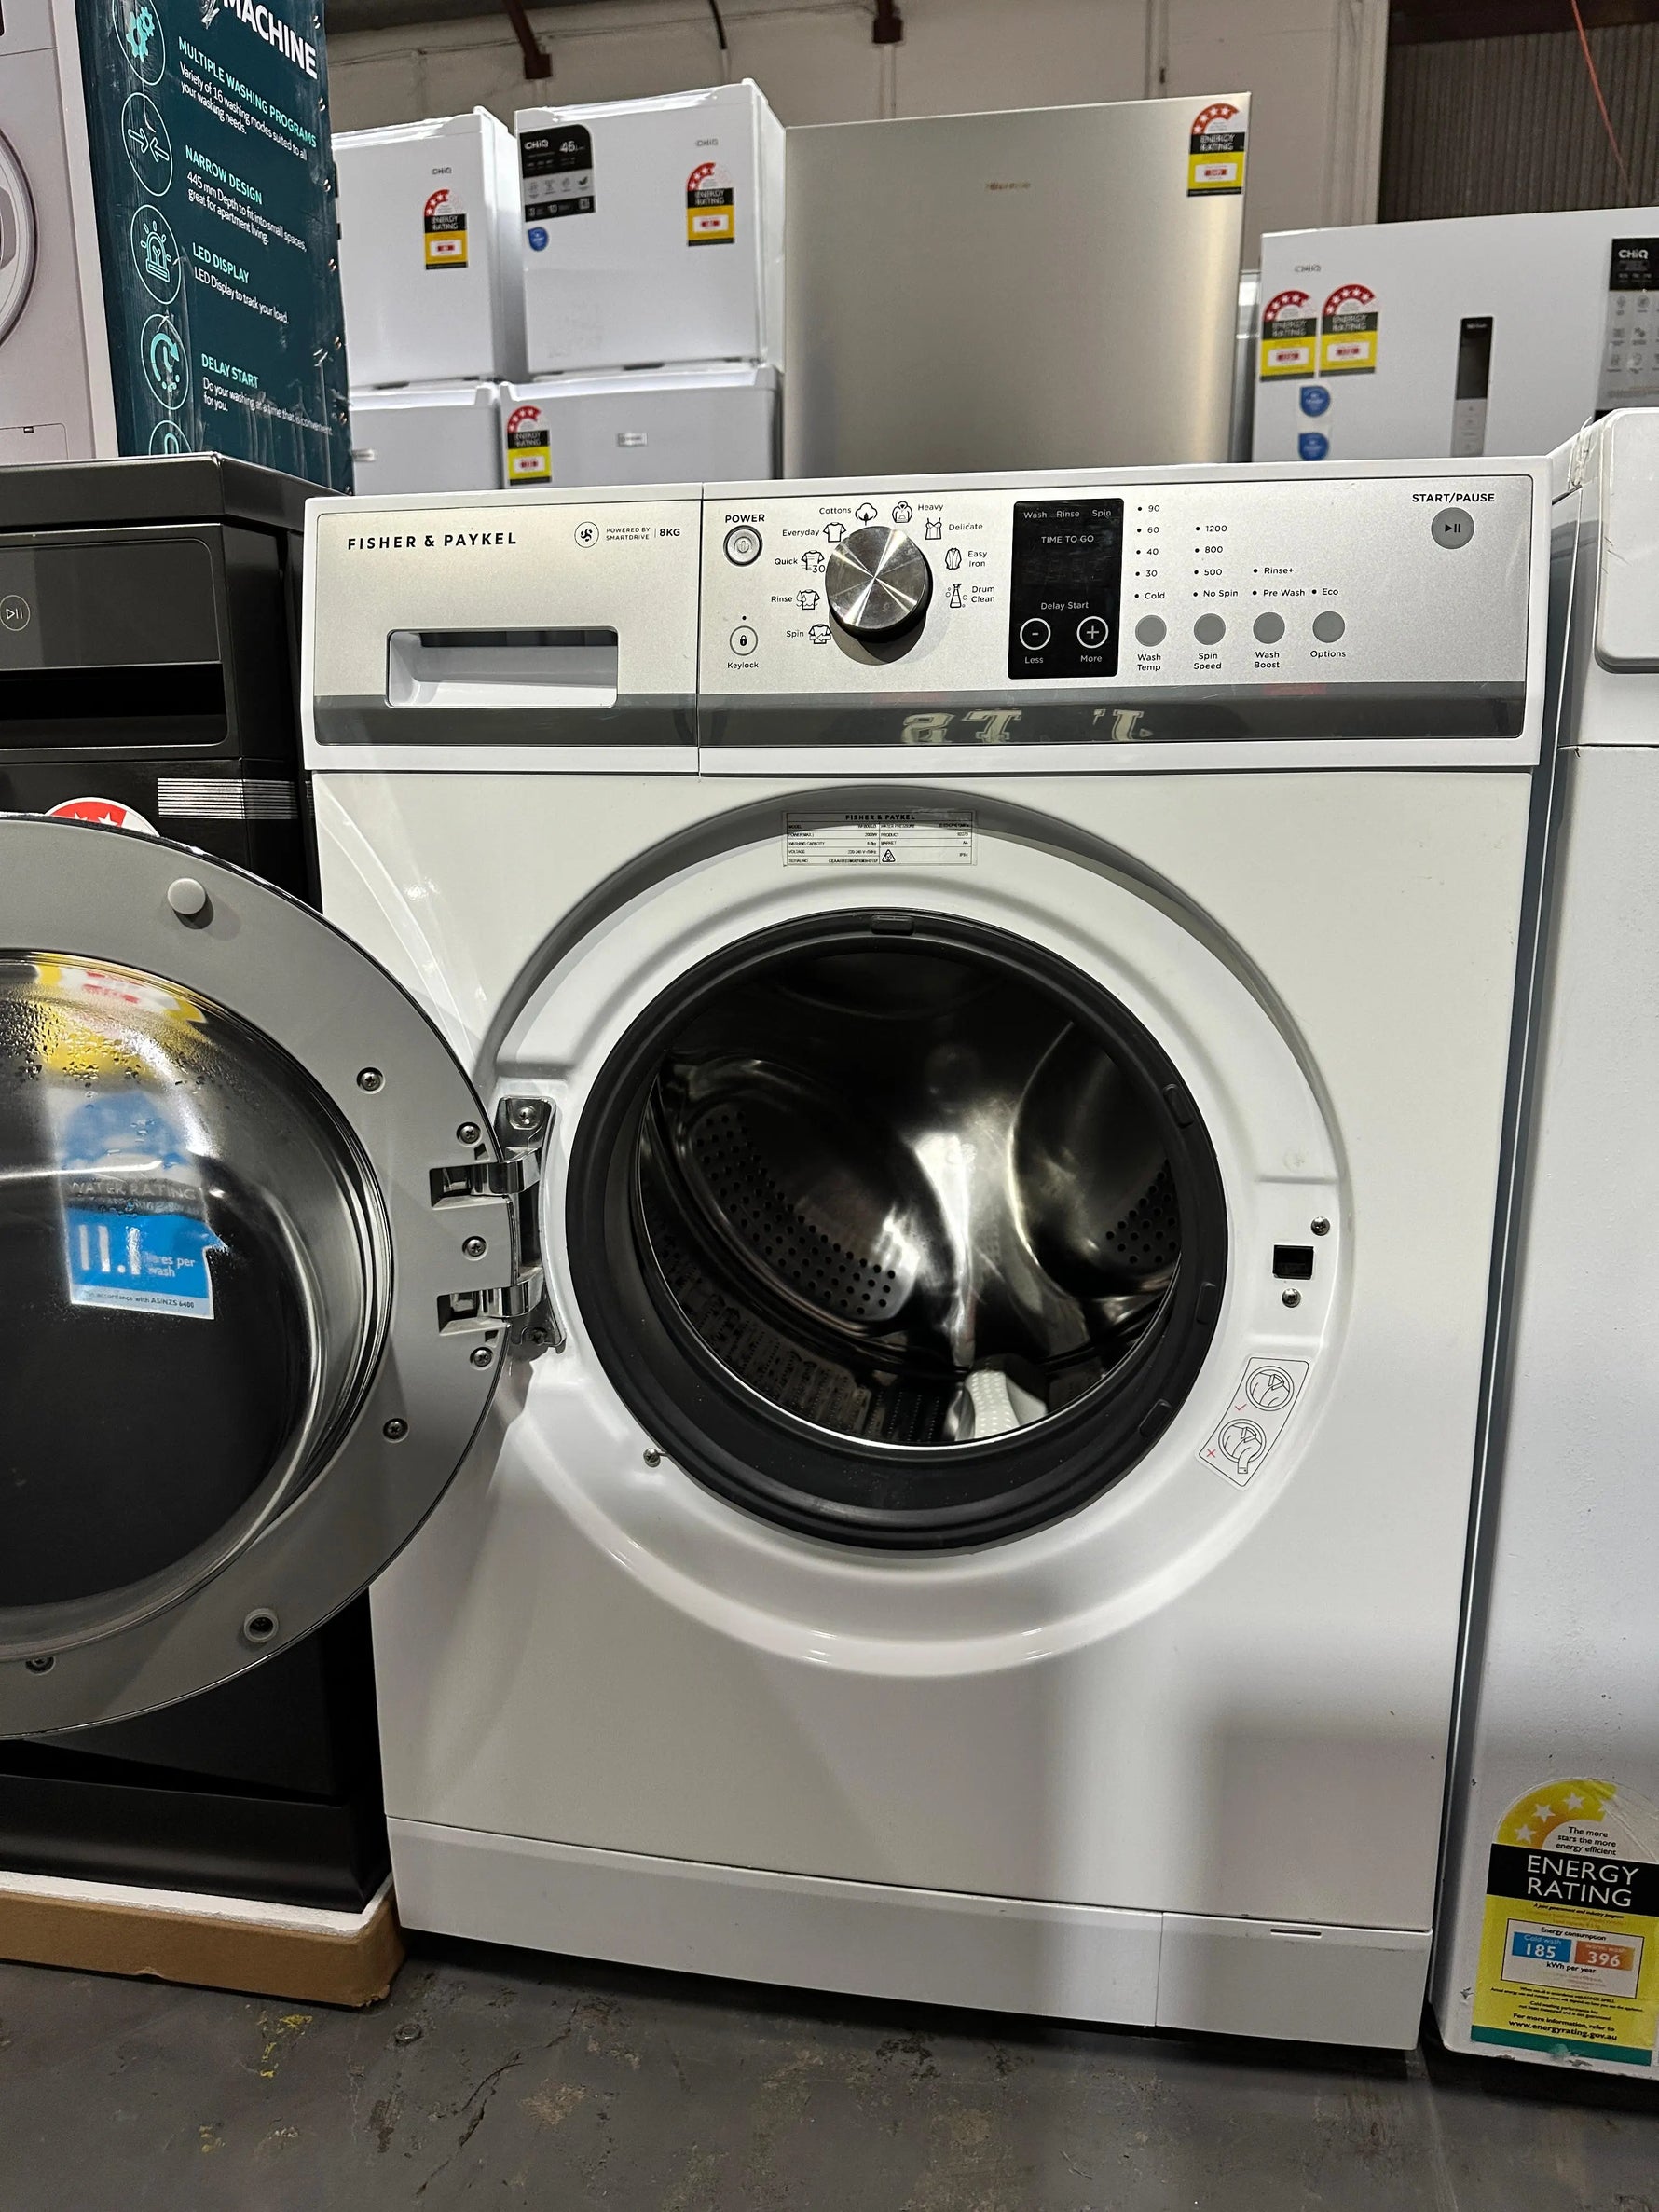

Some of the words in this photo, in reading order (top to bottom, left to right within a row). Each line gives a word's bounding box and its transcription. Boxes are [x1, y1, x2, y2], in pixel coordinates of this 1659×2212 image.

[179, 35, 226, 83] MULTIPLE
[226, 72, 268, 115] WASHING
[269, 104, 317, 147] PROGRAMS
[179, 60, 204, 92] Variety
[204, 81, 213, 95] of
[213, 86, 224, 103] 16
[223, 96, 251, 126] washing
[250, 117, 272, 138] modes
[272, 131, 293, 151] suited
[292, 143, 300, 157] to
[181, 80, 197, 99] your
[197, 92, 226, 122] washing
[225, 112, 247, 135] needs.
[185, 144, 228, 184] NARROW
[228, 172, 263, 205] DESIGN
[186, 171, 203, 189] 445
[203, 183, 217, 199] mm
[216, 187, 239, 212] Depth
[238, 202, 247, 216] to
[246, 205, 254, 221] fit
[254, 211, 267, 228] into
[187, 188, 207, 207] great
[206, 195, 217, 213] for
[216, 206, 251, 233] apartment
[192, 241, 212, 264] LED
[212, 253, 250, 284] DISPLAY
[194, 266, 211, 284] LED
[210, 274, 235, 301] Display
[234, 289, 243, 302] to
[242, 293, 260, 310] track
[258, 302, 274, 315] your
[201, 352, 231, 378] DELAY
[230, 365, 259, 389] START
[202, 376, 214, 392] Do
[213, 384, 229, 398] your
[203, 391, 214, 406] for
[213, 398, 229, 412] you.
[1411, 493, 1495, 504] START/PAUSE
[819, 505, 852, 515] Cottons
[917, 502, 944, 513] Heavy
[725, 514, 765, 523] POWER
[1023, 510, 1048, 519] Wash
[1056, 510, 1080, 518] Rinse
[1091, 509, 1112, 519] Spin
[948, 522, 983, 531] Delicate
[1147, 526, 1159, 534] 60
[1205, 525, 1227, 533] 1200
[606, 533, 651, 542] SMARTDRIVE
[659, 528, 681, 538] 8KG
[782, 528, 820, 538] Everyday
[1041, 535, 1063, 543] TIME
[1065, 535, 1077, 543] TO
[1079, 534, 1094, 543] GO
[348, 535, 417, 551] FISHER
[424, 534, 435, 548] &
[444, 532, 517, 547] PAYKEL
[967, 550, 988, 560] Easy
[775, 556, 799, 566] Quick
[812, 564, 826, 573] 30
[968, 559, 986, 568] Iron
[1145, 570, 1158, 578] 30
[1203, 568, 1223, 576] 500
[1264, 566, 1294, 575] Rinse+
[971, 585, 995, 594] Drum
[1203, 589, 1216, 598] No
[1218, 588, 1239, 599] Spin
[1263, 589, 1278, 598] Pre
[1279, 588, 1305, 598] Wash
[771, 595, 793, 603] Rinse
[971, 594, 995, 603] Clean
[1145, 591, 1165, 600] Cold
[1040, 601, 1065, 611] Delay
[1067, 600, 1090, 610] Start
[786, 629, 804, 639] Spin
[1024, 655, 1044, 665] Less
[1080, 654, 1103, 664] More
[1137, 653, 1161, 662] Wash
[1198, 652, 1218, 662] Spin
[1255, 651, 1280, 659] Wash
[1309, 649, 1346, 660] Options
[727, 660, 759, 670] Keylock
[1137, 663, 1161, 673] Temp
[1193, 661, 1222, 672] Speed
[1254, 660, 1280, 668] Boost
[78, 1224, 141, 1276] 11.1
[177, 1257, 196, 1269] per
[147, 1265, 176, 1277] wash
[1569, 1826, 1584, 1835] The
[1586, 1830, 1608, 1838] more
[1557, 1834, 1577, 1843] stars
[1579, 1836, 1593, 1845] the
[1595, 1839, 1616, 1848] more
[1556, 1843, 1584, 1853] energy
[1584, 1846, 1616, 1856] efficient
[1528, 1854, 1639, 1886] ENERGY
[1528, 1876, 1632, 1907] RATING
[1541, 1927, 1564, 1937] Energy
[1565, 1930, 1607, 1941] consumption
[1526, 1943, 1556, 1958] 185
[1587, 1951, 1621, 1967] 396
[1546, 1961, 1565, 1970] kWh
[1566, 1964, 1580, 1972] per
[1580, 1967, 1597, 1975] year
[1513, 2013, 1526, 2021] For
[1526, 2014, 1545, 2023] more
[1546, 2017, 1588, 2029] information,
[1508, 2020, 1618, 2041] www.energyrating.gov.au
